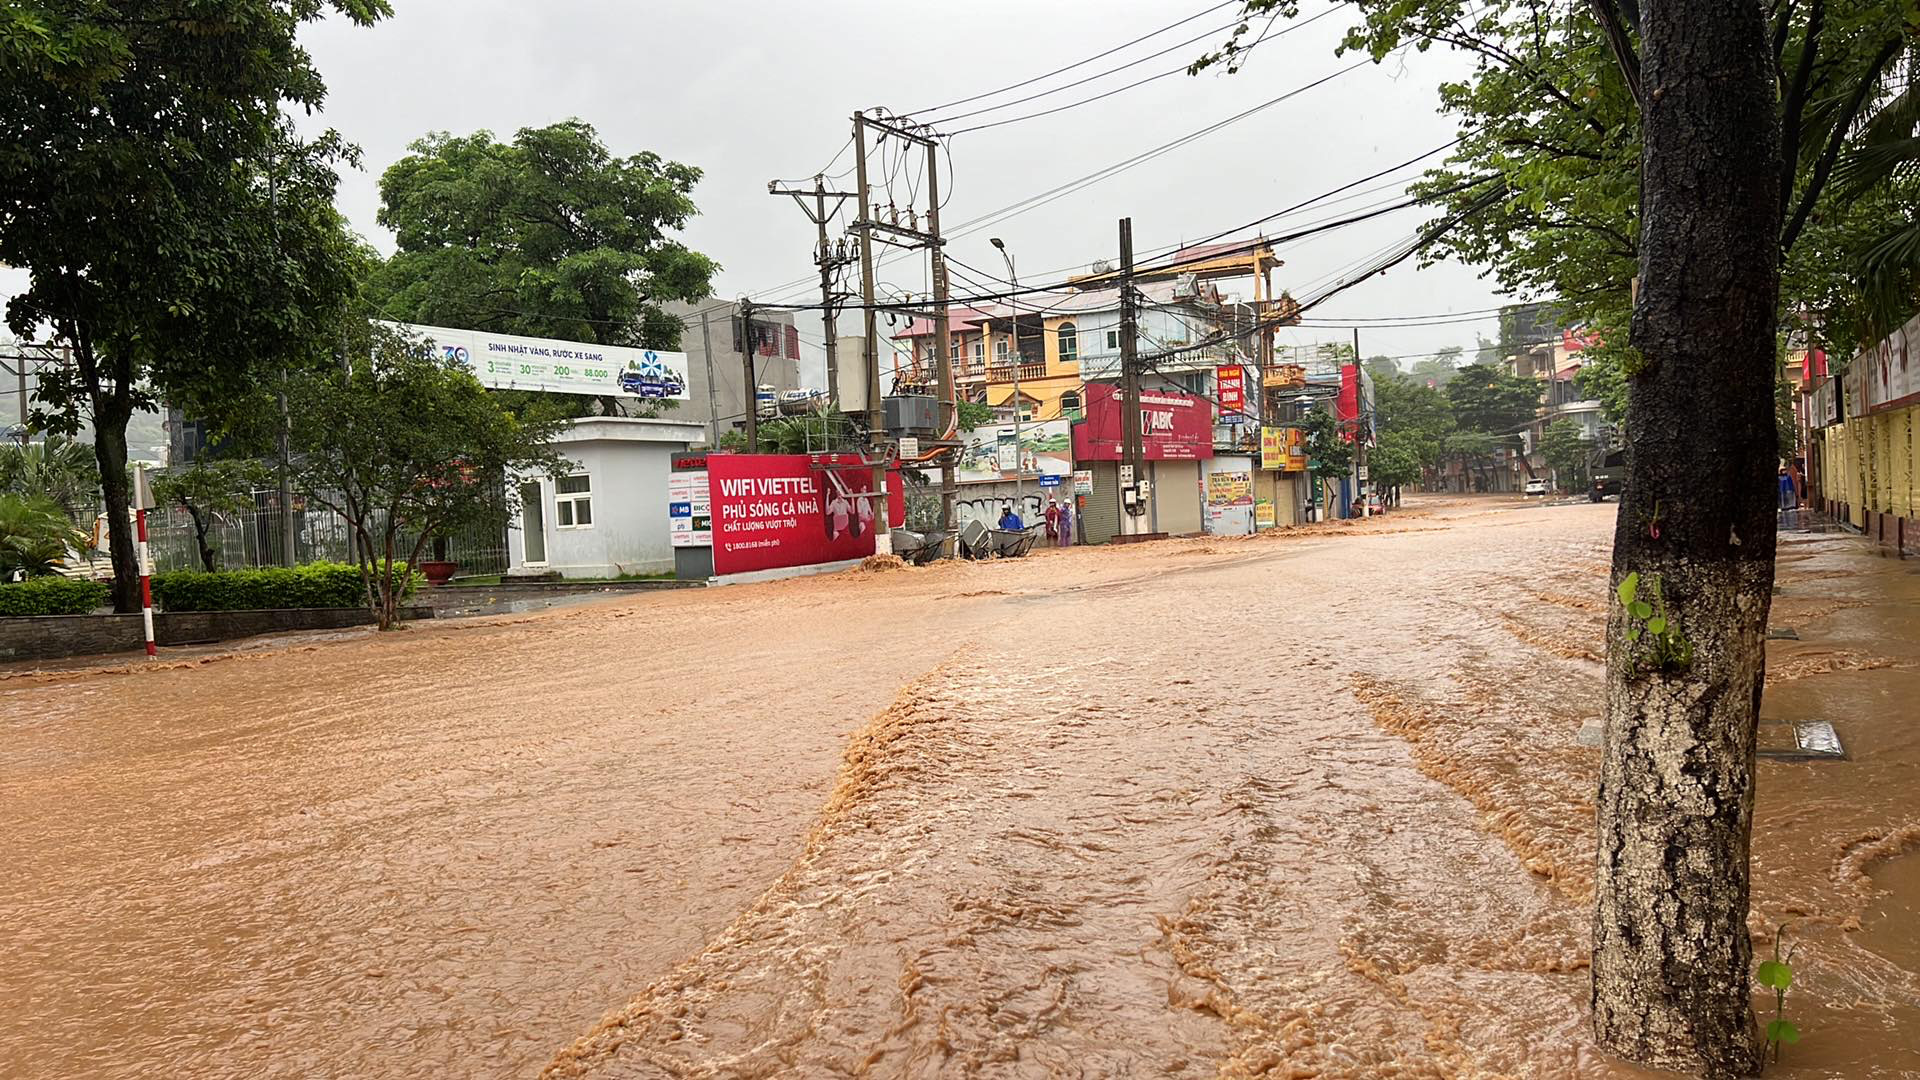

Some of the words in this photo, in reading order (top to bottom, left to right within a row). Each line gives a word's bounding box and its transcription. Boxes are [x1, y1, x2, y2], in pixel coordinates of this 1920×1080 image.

[488, 343, 507, 352] SINH
[508, 344, 528, 356] NHẬT
[574, 351, 583, 360] XE
[584, 352, 603, 361] SANG
[487, 360, 495, 373] 3
[520, 364, 531, 375] 30
[554, 365, 570, 376] 200
[584, 368, 609, 378] 88.000
[1222, 390, 1238, 402] BÌNH
[1152, 410, 1174, 430] ABIC
[720, 478, 755, 497] WIFI
[757, 477, 818, 496] VIETTEL
[722, 499, 747, 519] PHỦ
[749, 499, 780, 518] SÓNG
[781, 497, 796, 516] CẢ
[797, 497, 820, 515] NHÀ
[723, 519, 741, 533] CHẤT
[742, 520, 765, 532] LƯỢNG
[765, 519, 782, 530] VƯỢT
[783, 517, 797, 528] TRỘI
